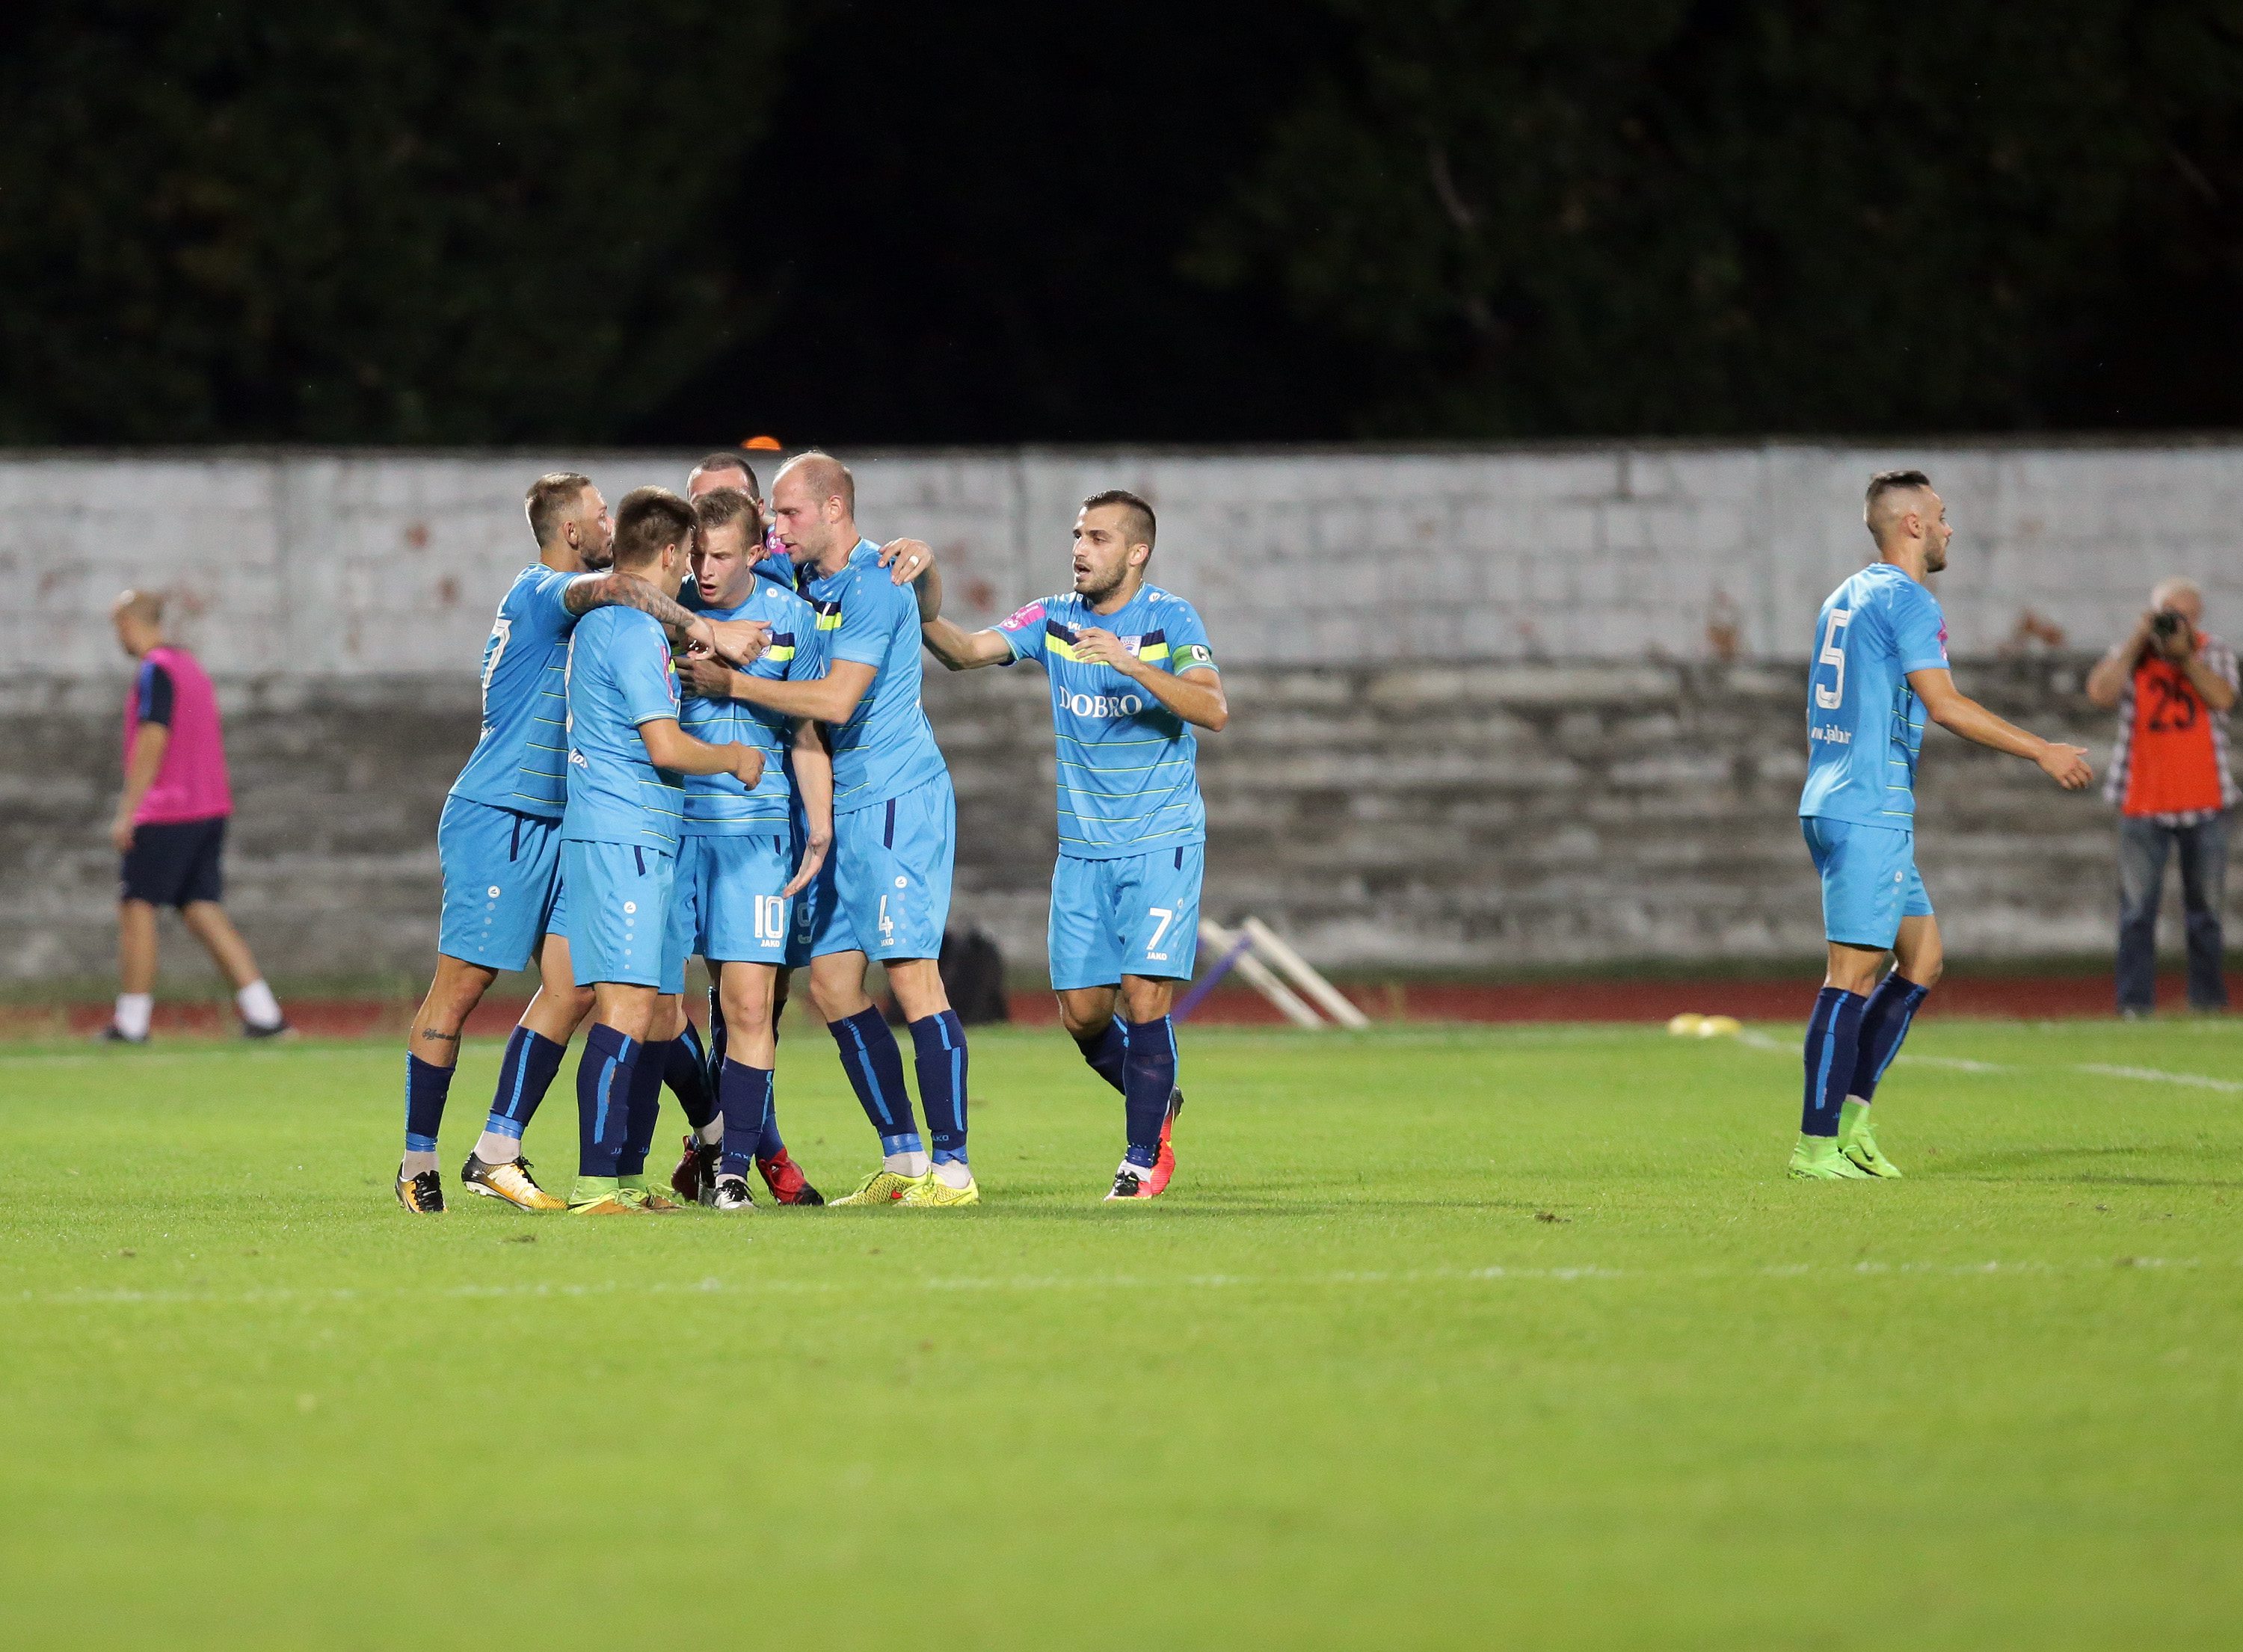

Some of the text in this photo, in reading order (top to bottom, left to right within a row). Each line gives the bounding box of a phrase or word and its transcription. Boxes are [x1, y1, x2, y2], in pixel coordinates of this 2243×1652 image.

[1190, 644, 1209, 662] C
[1815, 607, 1852, 710] 5
[1059, 685, 1142, 718] DOBRO
[2148, 675, 2196, 733] 25
[754, 895, 784, 939] 10
[879, 894, 894, 937] 4
[1145, 907, 1172, 950] 7
[760, 939, 781, 948] JAKO
[1146, 952, 1169, 961] JAKO
[932, 1134, 950, 1142] AKO
